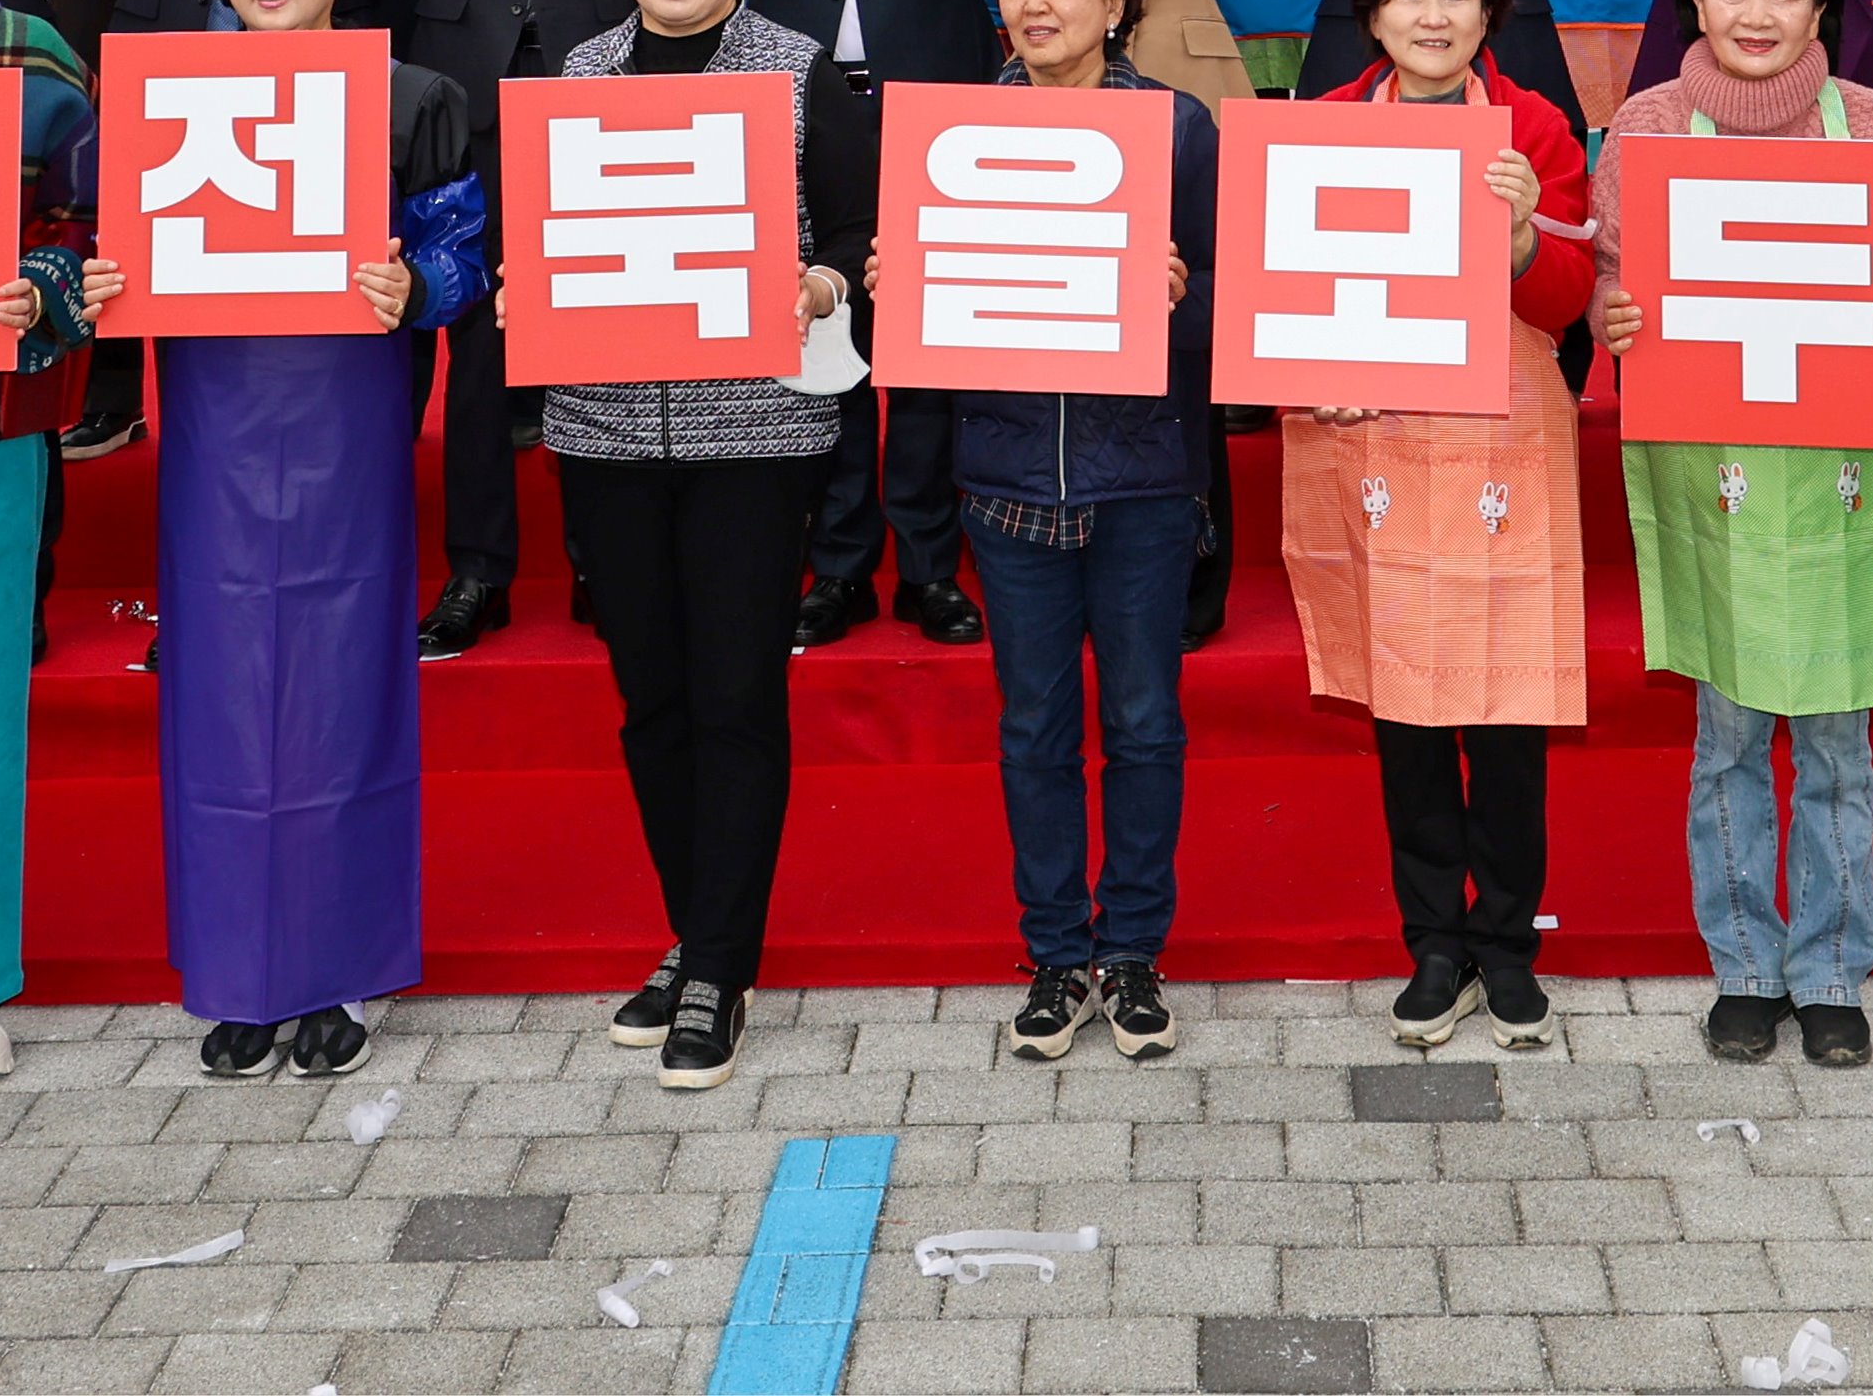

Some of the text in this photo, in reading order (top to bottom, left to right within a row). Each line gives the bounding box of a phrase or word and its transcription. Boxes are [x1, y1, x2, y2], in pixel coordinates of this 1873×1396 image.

[142, 72, 347, 293] 전
[544, 113, 754, 338] 북
[918, 126, 1127, 351] 을
[1254, 145, 1466, 364] 모
